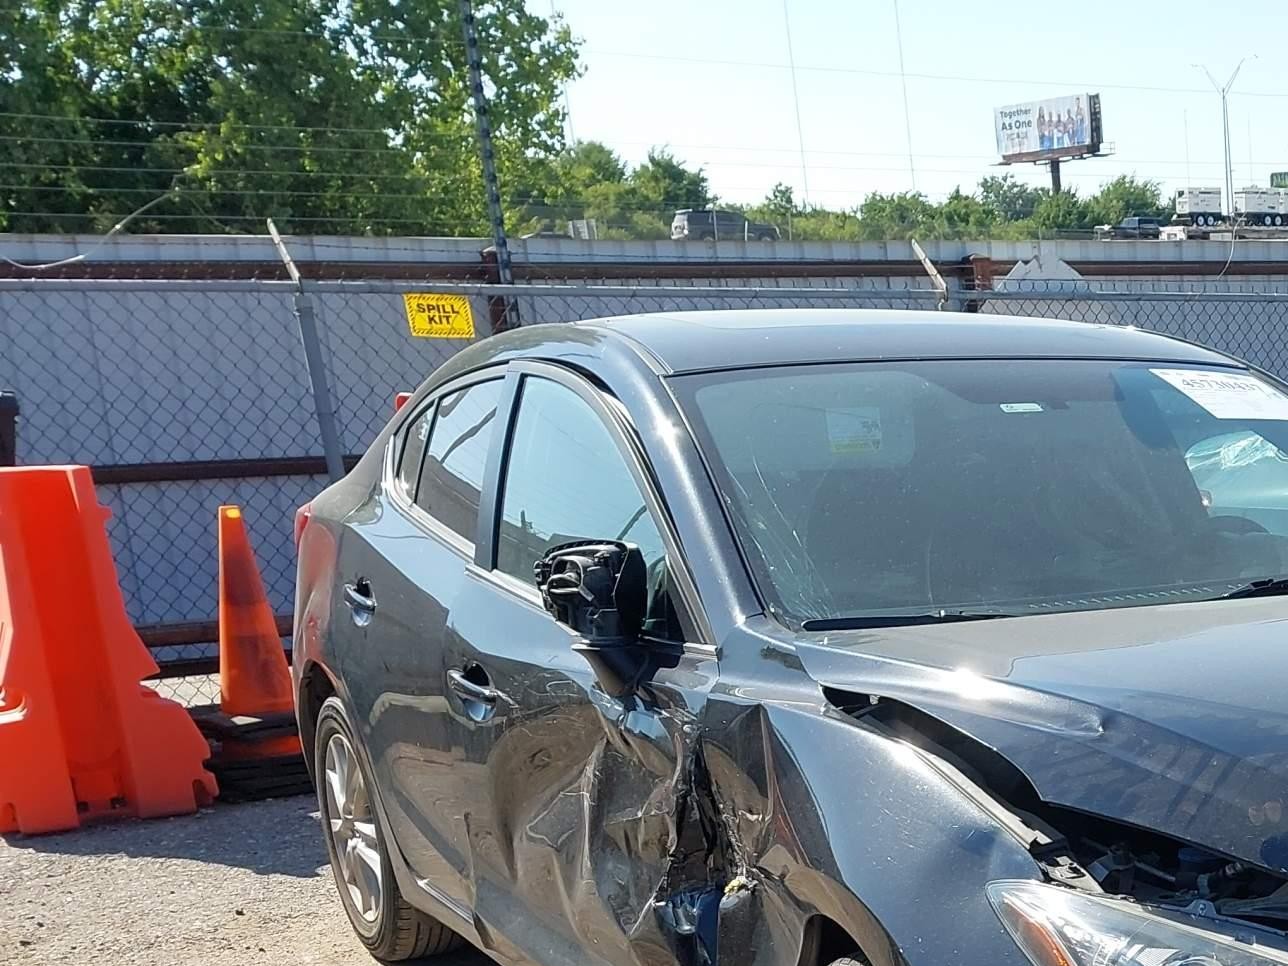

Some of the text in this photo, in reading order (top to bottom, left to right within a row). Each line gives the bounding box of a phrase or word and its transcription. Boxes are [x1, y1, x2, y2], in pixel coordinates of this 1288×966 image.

[1000, 108, 1031, 119] Together
[1002, 119, 1033, 131] As One
[416, 303, 460, 314] SPILL
[427, 315, 452, 325] KIT
